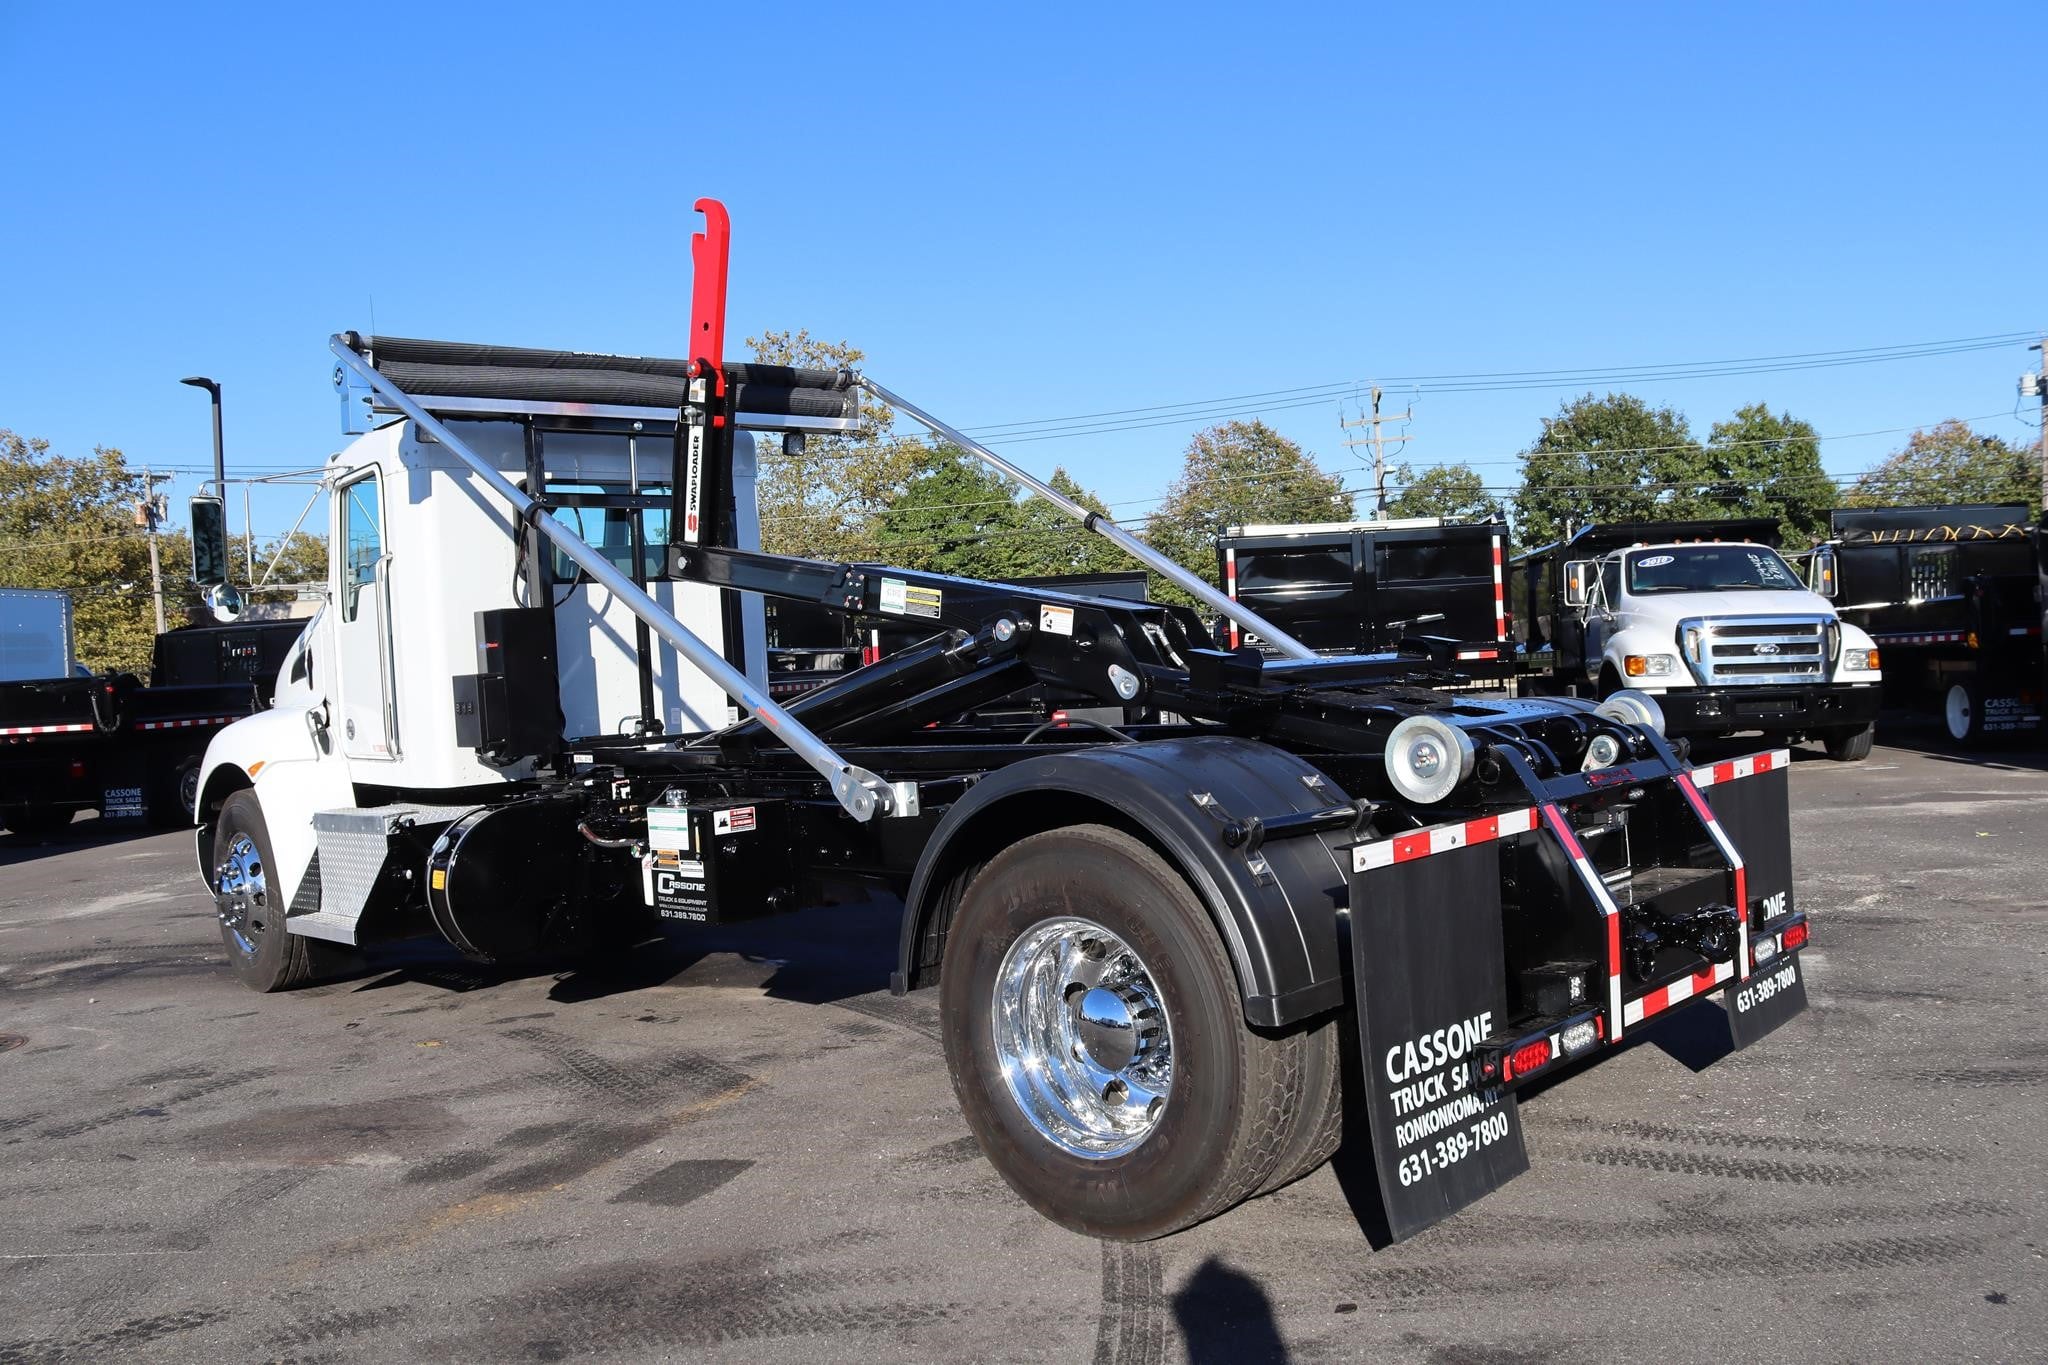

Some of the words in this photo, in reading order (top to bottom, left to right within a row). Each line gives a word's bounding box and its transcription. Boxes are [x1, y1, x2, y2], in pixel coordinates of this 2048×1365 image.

[690, 435, 700, 511] SWAPLOADER
[105, 788, 142, 798] CASSONE
[660, 909, 706, 921] 631.389.7800
[1737, 965, 1796, 1013] 631-389-7800
[1386, 1011, 1492, 1084] CASSONE
[1390, 1072, 1448, 1117] TRUCK
[1398, 1111, 1509, 1187] 631-389-7800
